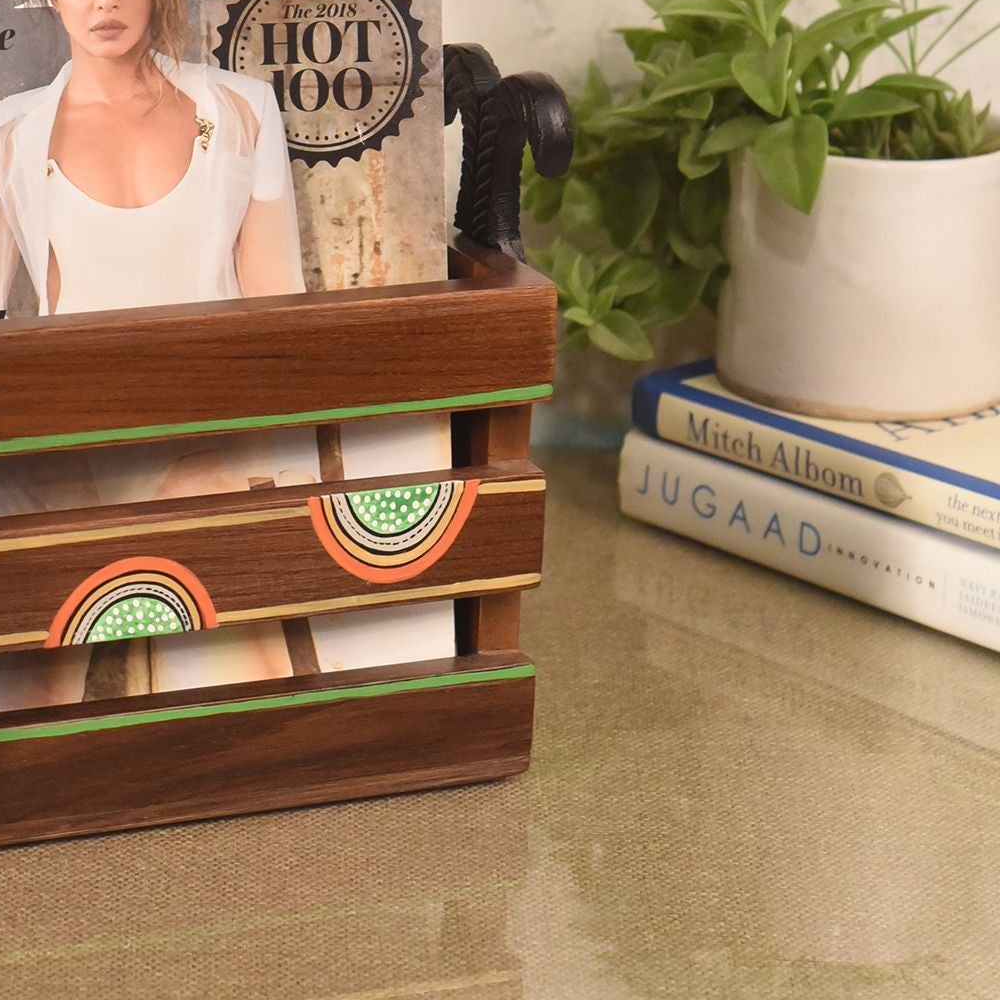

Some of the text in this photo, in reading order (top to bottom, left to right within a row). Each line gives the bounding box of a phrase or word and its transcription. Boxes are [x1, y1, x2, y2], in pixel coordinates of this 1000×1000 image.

[281, 2, 358, 20] The 2018
[259, 20, 382, 66] HOT
[271, 67, 374, 113] 100
[688, 411, 865, 498] Mitch Albom
[636, 464, 822, 557] JUGAAD
[936, 511, 995, 540] you meet
[947, 493, 969, 513] the
[827, 543, 936, 589] INNOVATION
